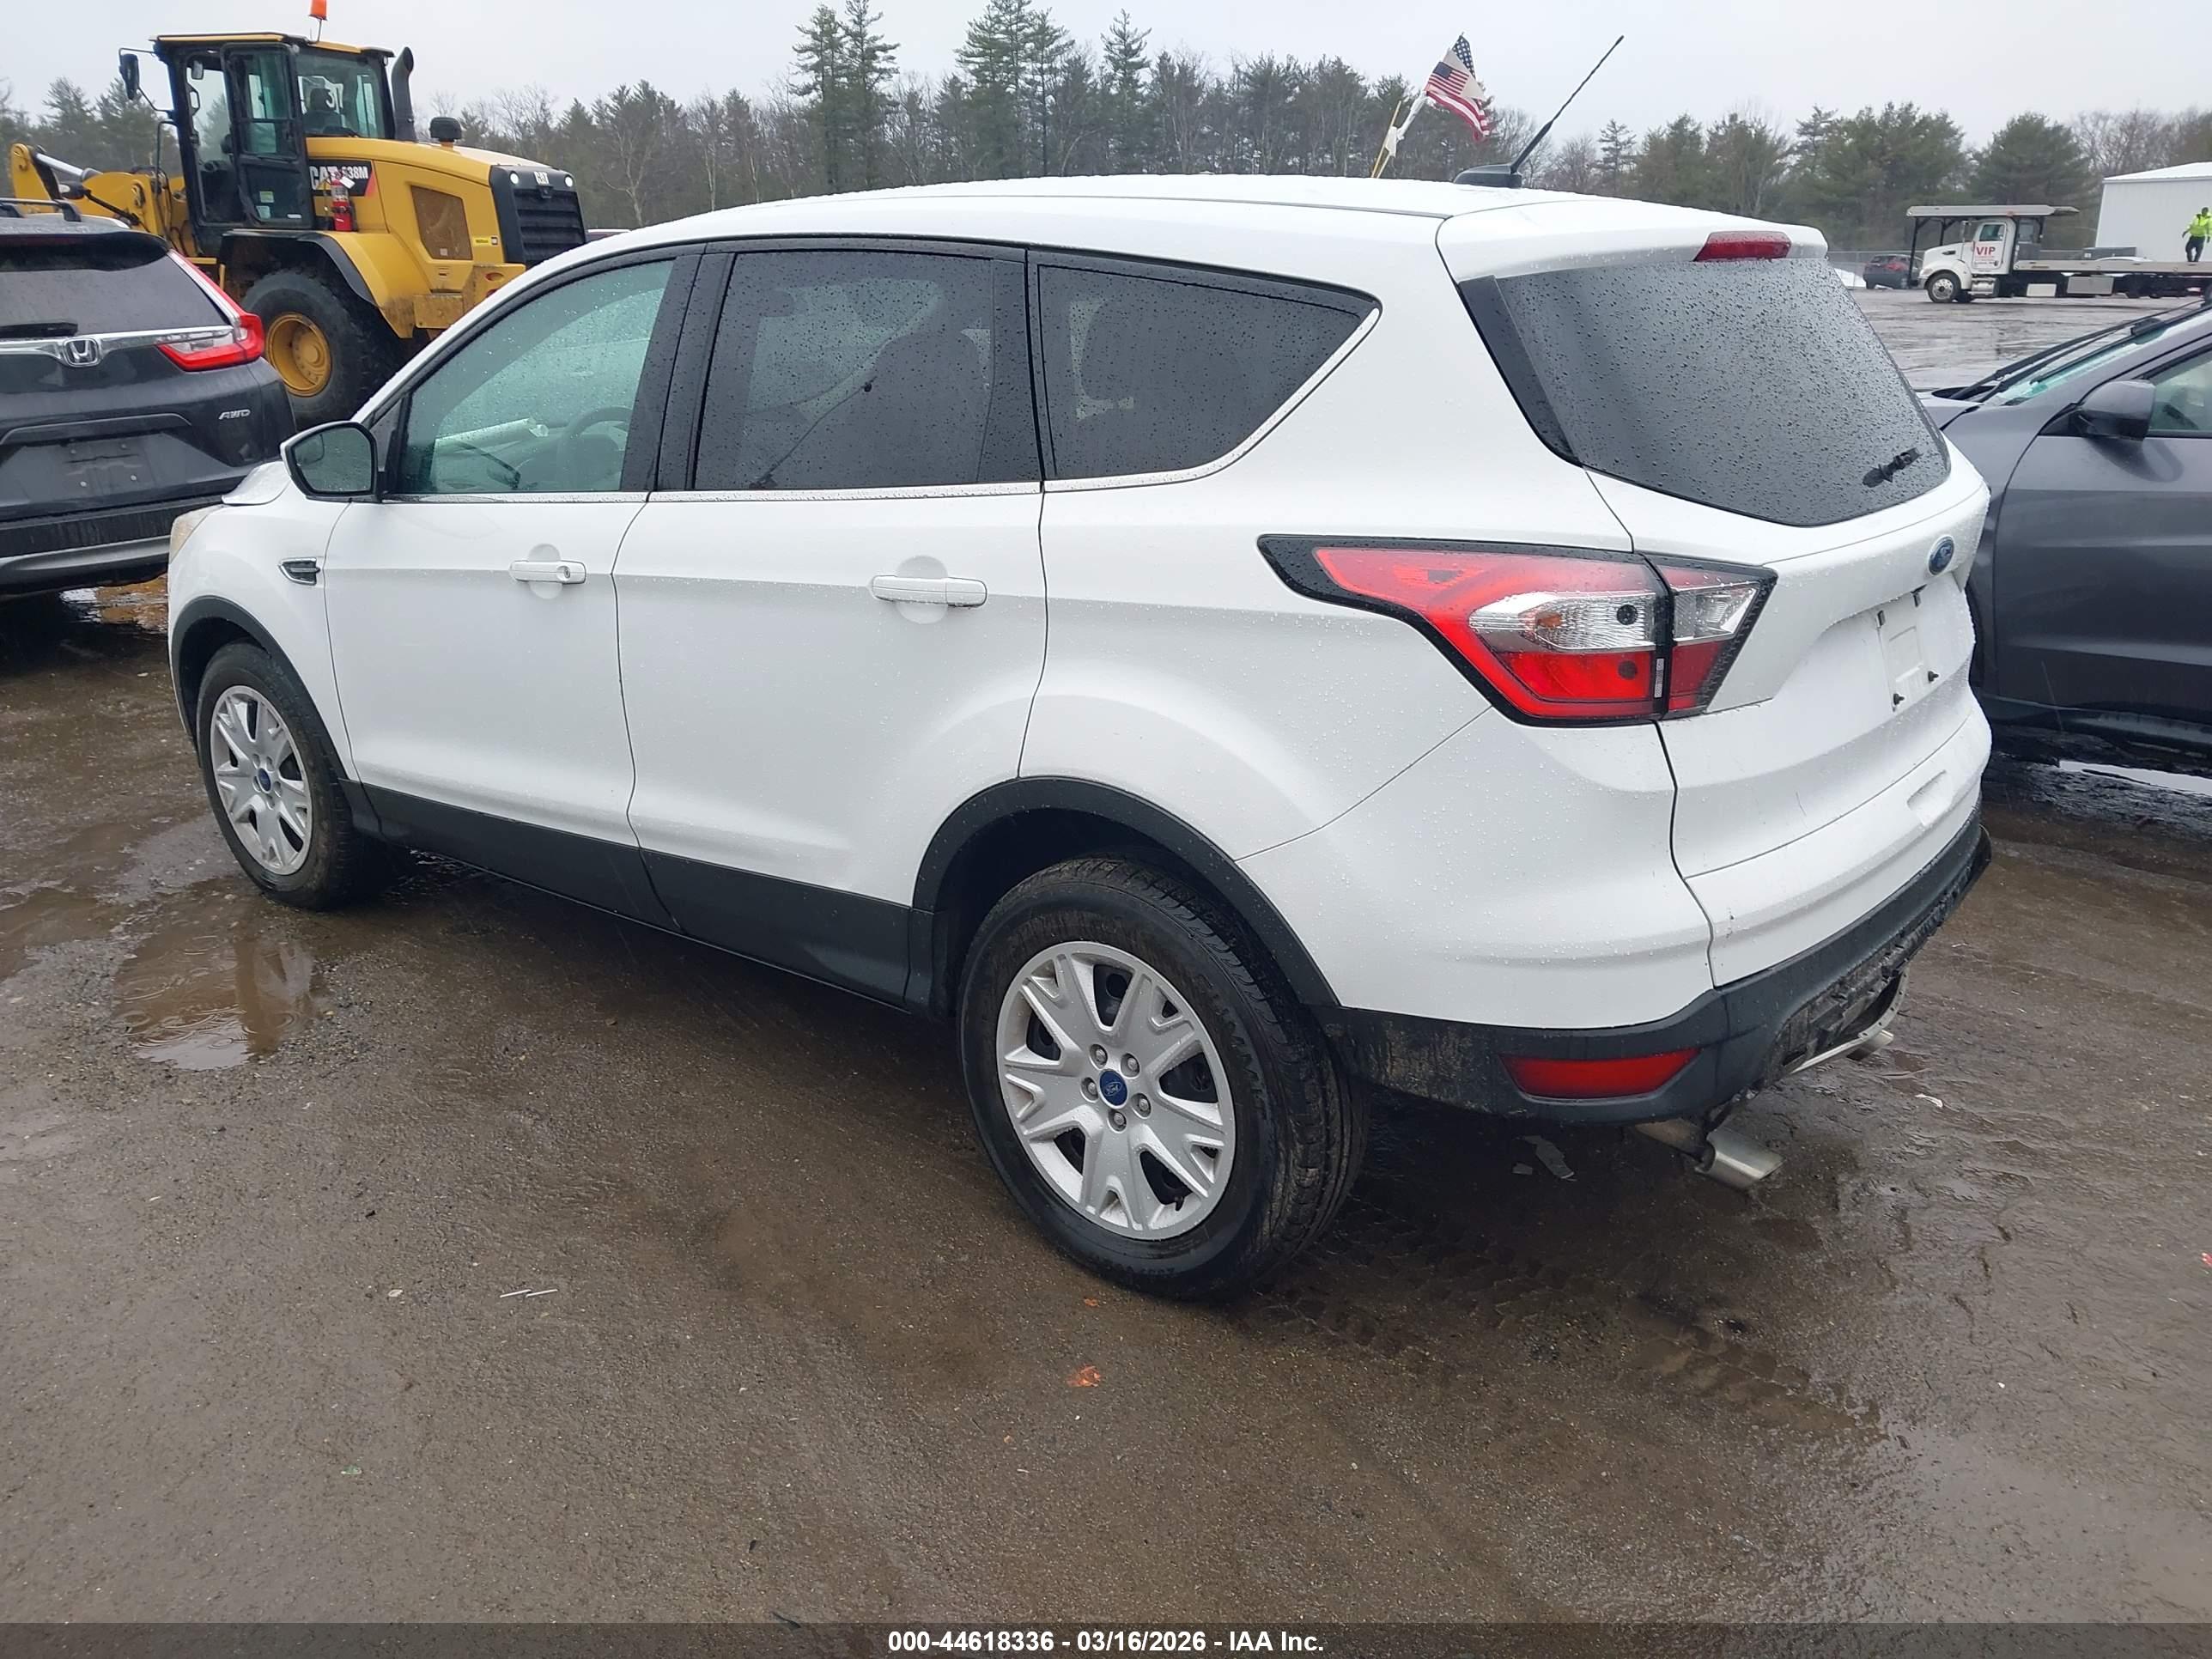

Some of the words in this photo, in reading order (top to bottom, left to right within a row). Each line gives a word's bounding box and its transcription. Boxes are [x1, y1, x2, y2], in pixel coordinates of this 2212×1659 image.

[309, 166, 338, 190] CAT
[1976, 246, 1996, 255] VIP
[218, 409, 251, 420] AWD
